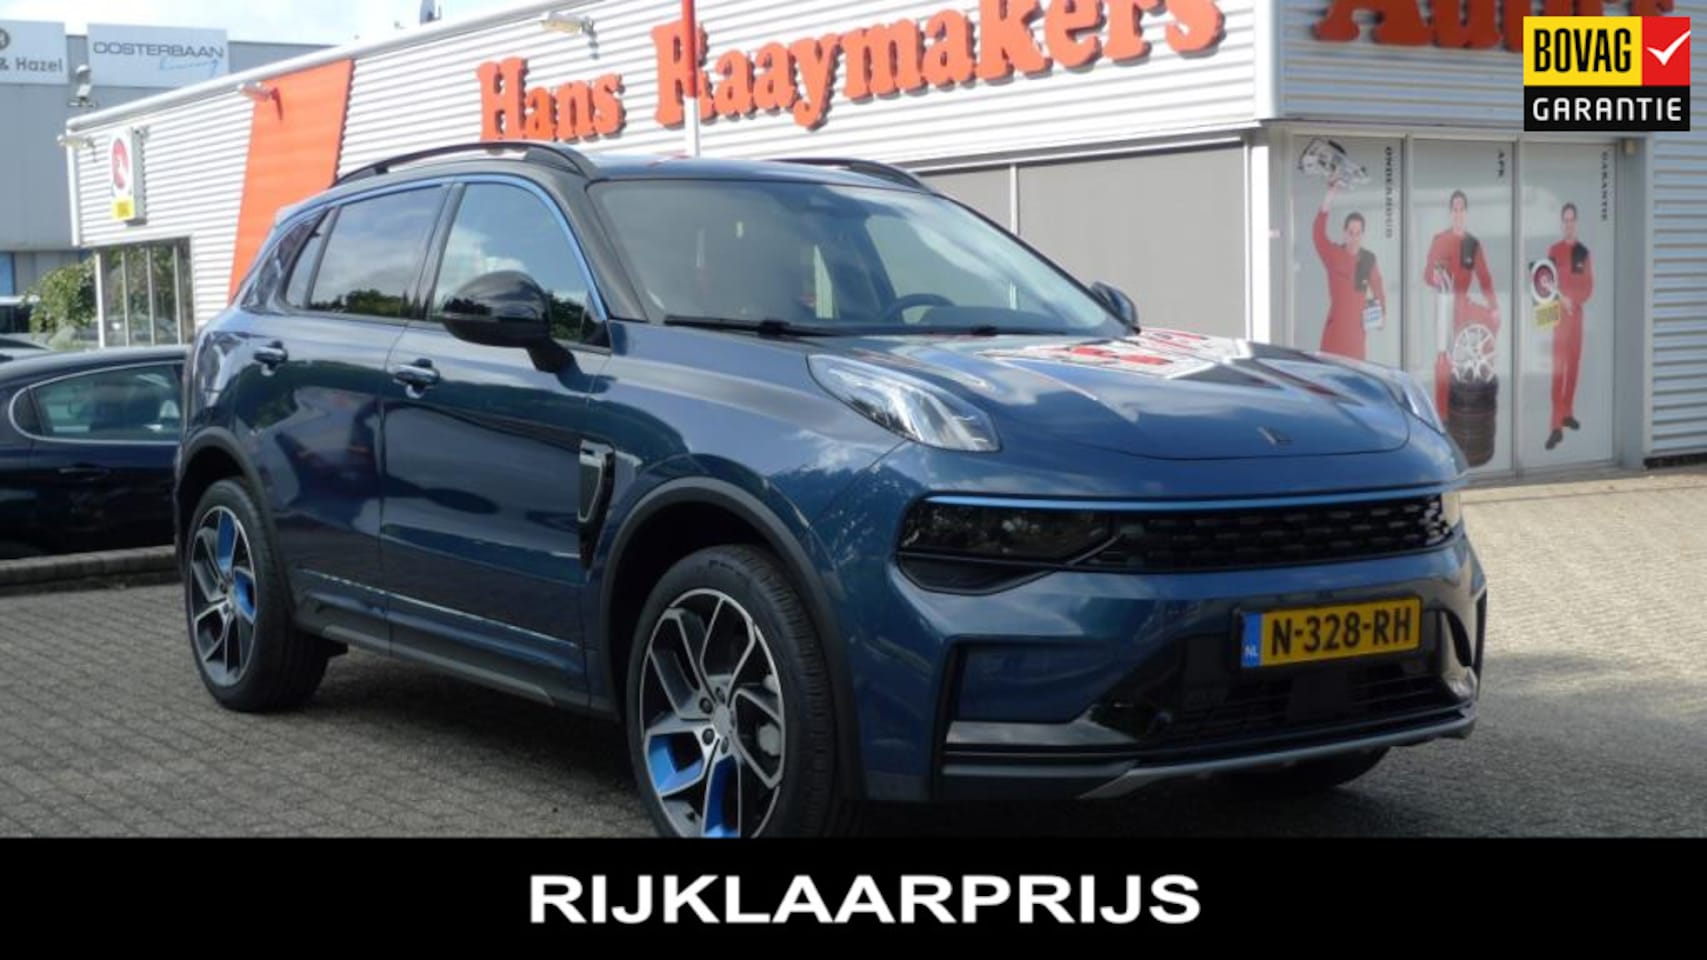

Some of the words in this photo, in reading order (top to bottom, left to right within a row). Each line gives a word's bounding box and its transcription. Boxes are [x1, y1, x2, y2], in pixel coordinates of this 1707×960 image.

[93, 41, 224, 59] OOSTERBAAN
[16, 57, 63, 73] Hazel
[476, 57, 627, 144] Hans
[651, 0, 1224, 131] Raaymakers
[1271, 607, 1412, 657] N-328-RH
[1244, 645, 1259, 657] NL
